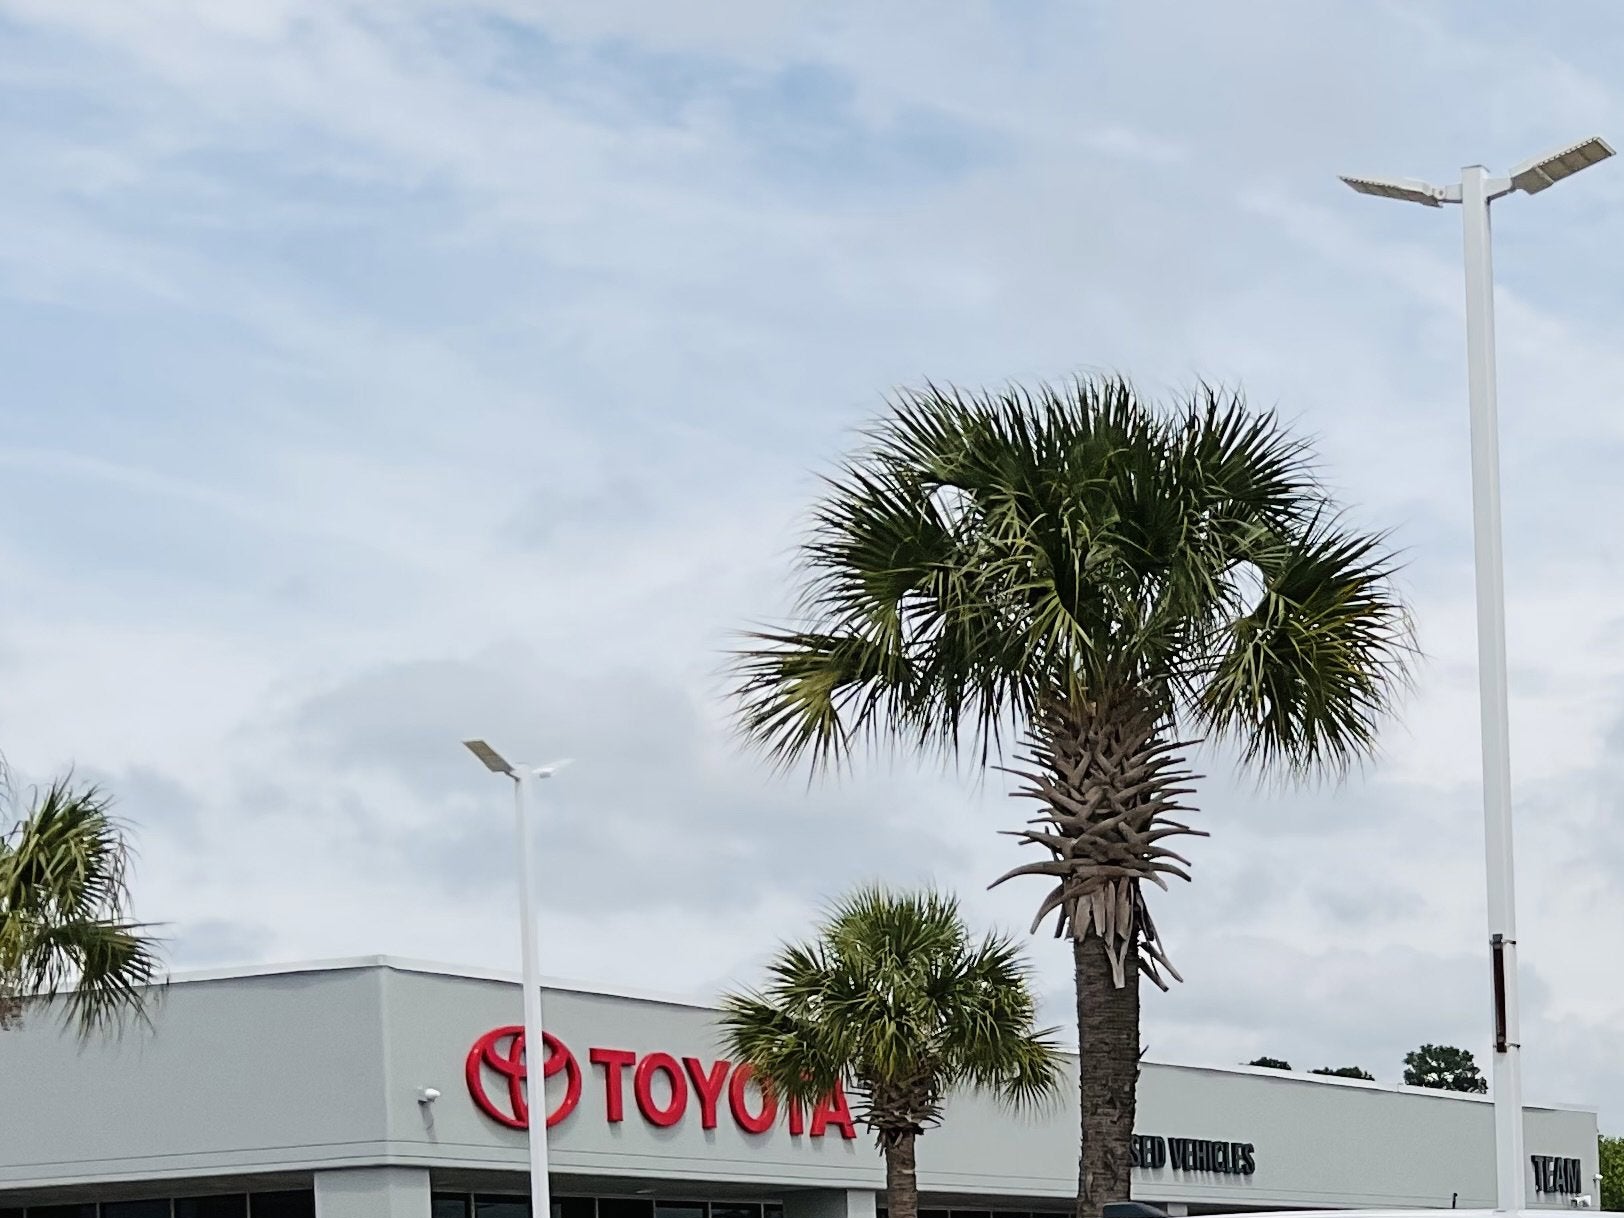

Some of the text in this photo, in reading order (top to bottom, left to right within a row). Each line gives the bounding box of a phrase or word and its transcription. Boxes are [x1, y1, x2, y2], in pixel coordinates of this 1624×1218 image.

[1129, 1134, 1255, 1175] SED VEHICLES
[1530, 1155, 1582, 1194] TEAM
